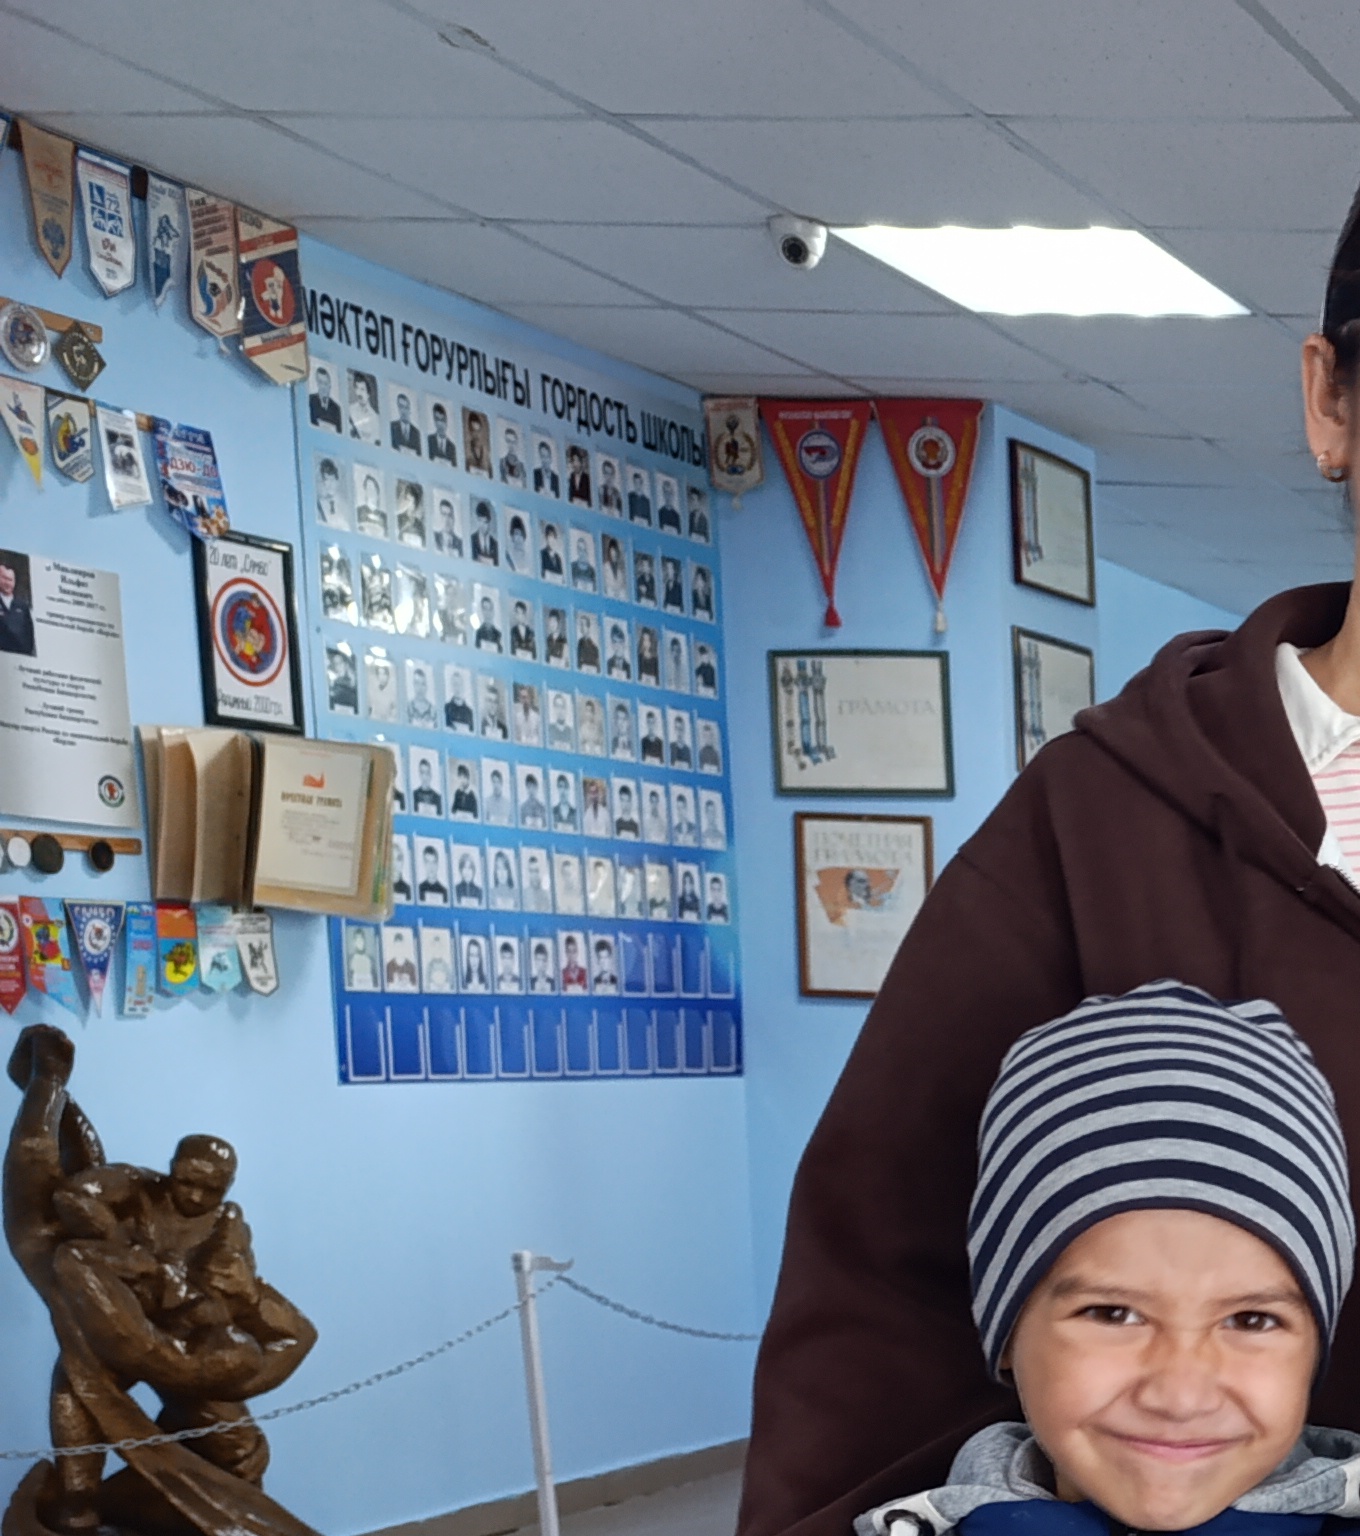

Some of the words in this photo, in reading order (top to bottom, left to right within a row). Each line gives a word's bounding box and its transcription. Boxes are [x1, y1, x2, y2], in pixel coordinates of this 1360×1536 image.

[302, 286, 398, 362] МӘКТӘП
[540, 372, 638, 441] ГОРДОСТЬ
[640, 409, 707, 470] ШКОЛЫ
